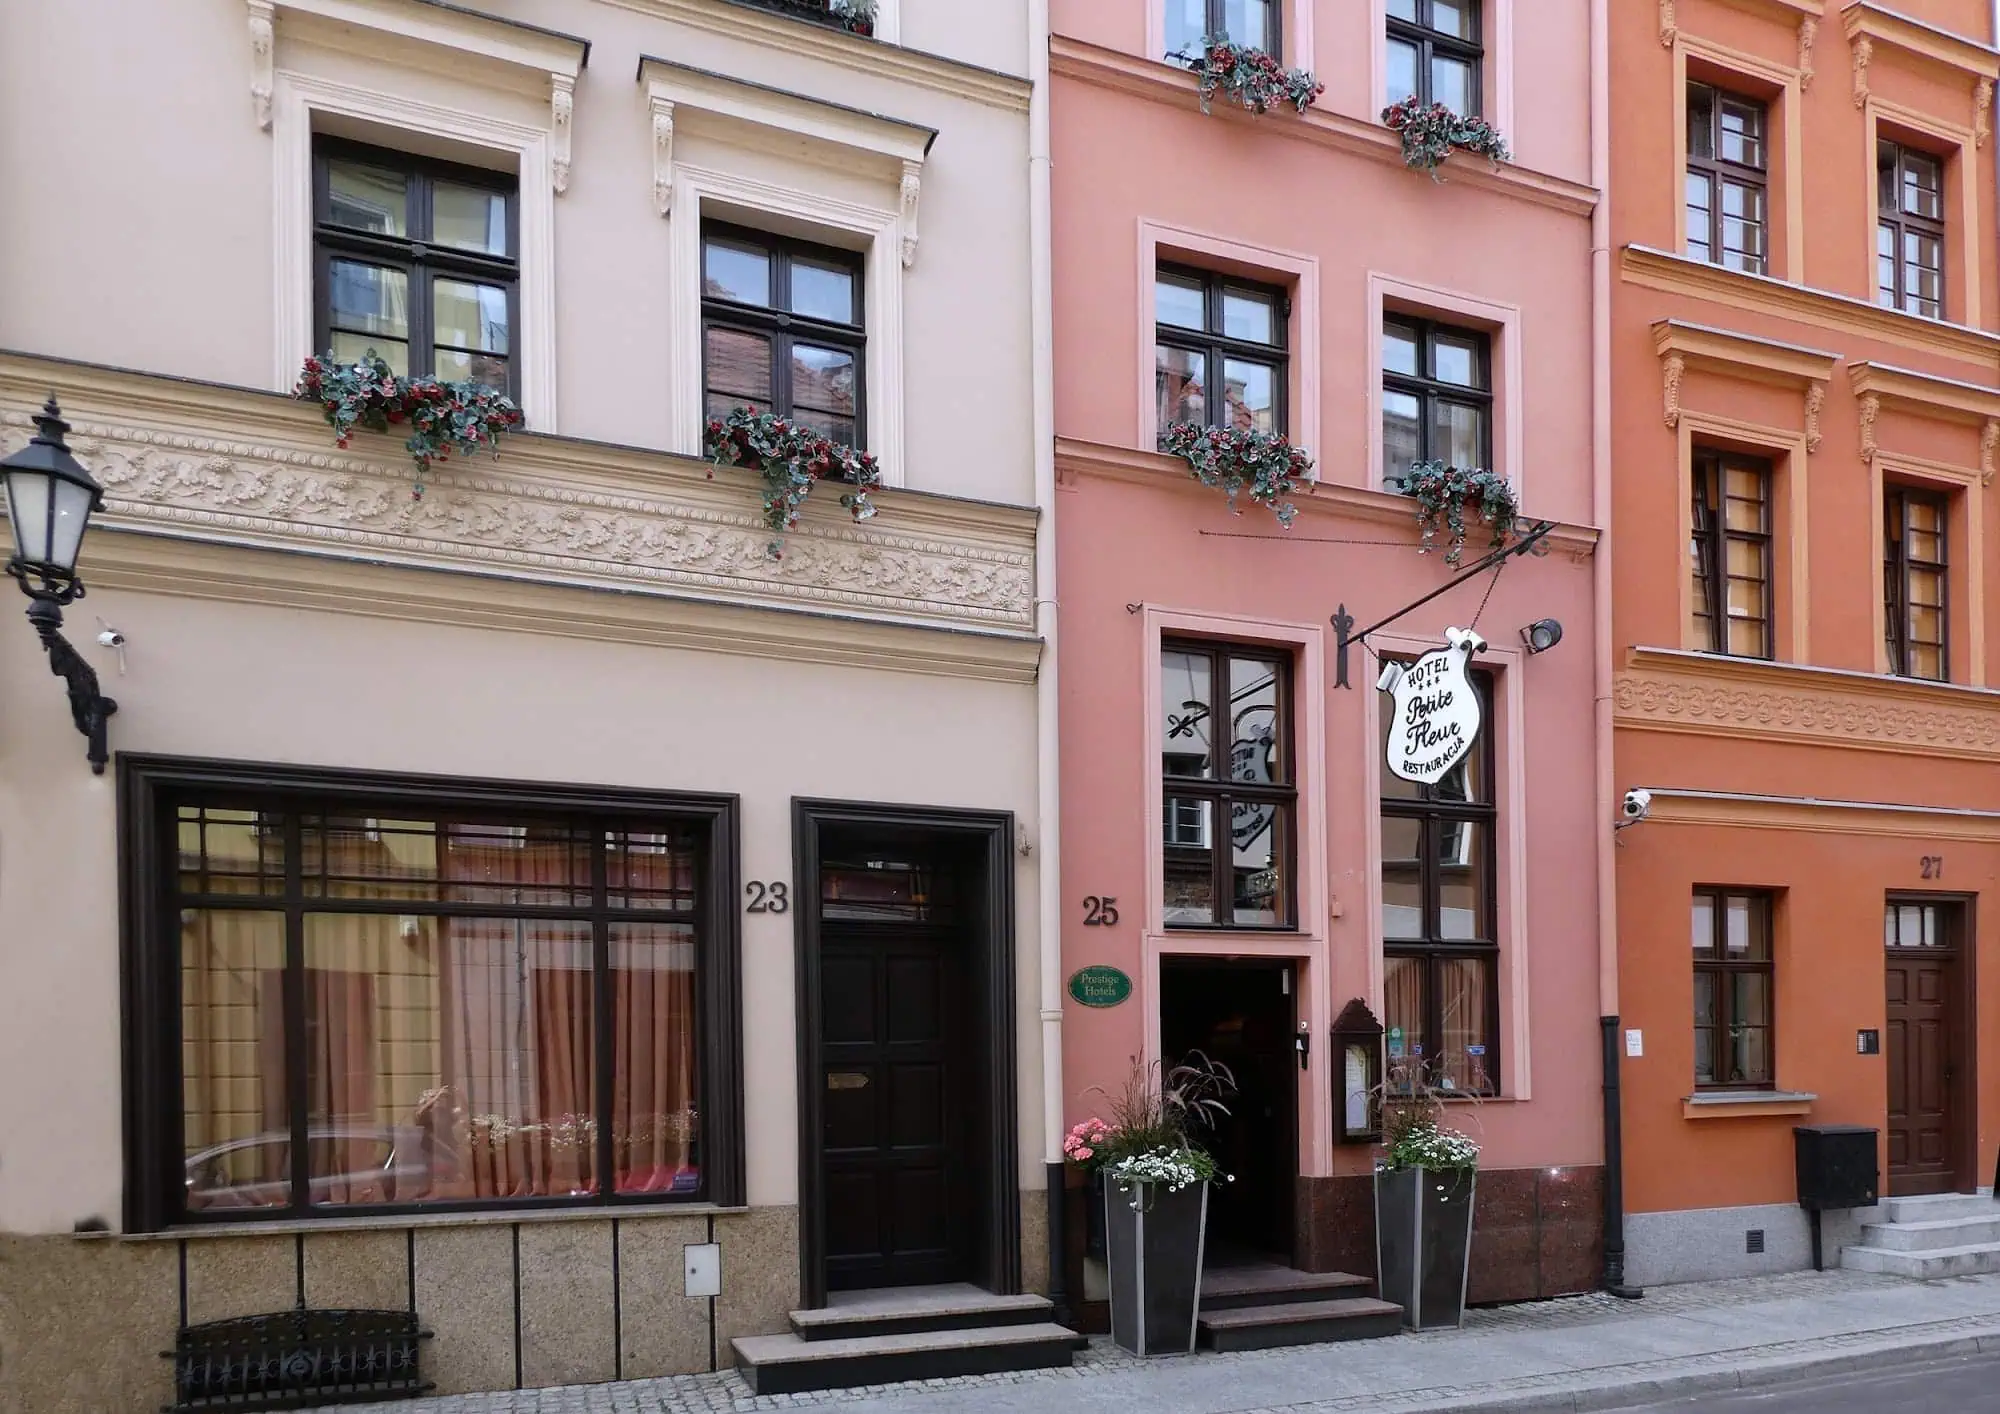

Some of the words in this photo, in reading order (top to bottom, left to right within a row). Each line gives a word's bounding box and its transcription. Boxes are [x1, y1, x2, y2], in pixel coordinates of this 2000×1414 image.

[1408, 657, 1449, 687] HOTEL
[1406, 690, 1453, 725] Petite
[1405, 718, 1461, 755] Fleur
[1402, 736, 1465, 774] RESTAURACJA
[1920, 856, 1942, 879] 27
[746, 881, 788, 913] 23
[1083, 896, 1119, 926] 25
[1081, 973, 1120, 985] Prestige
[1085, 986, 1116, 996] Hotels
